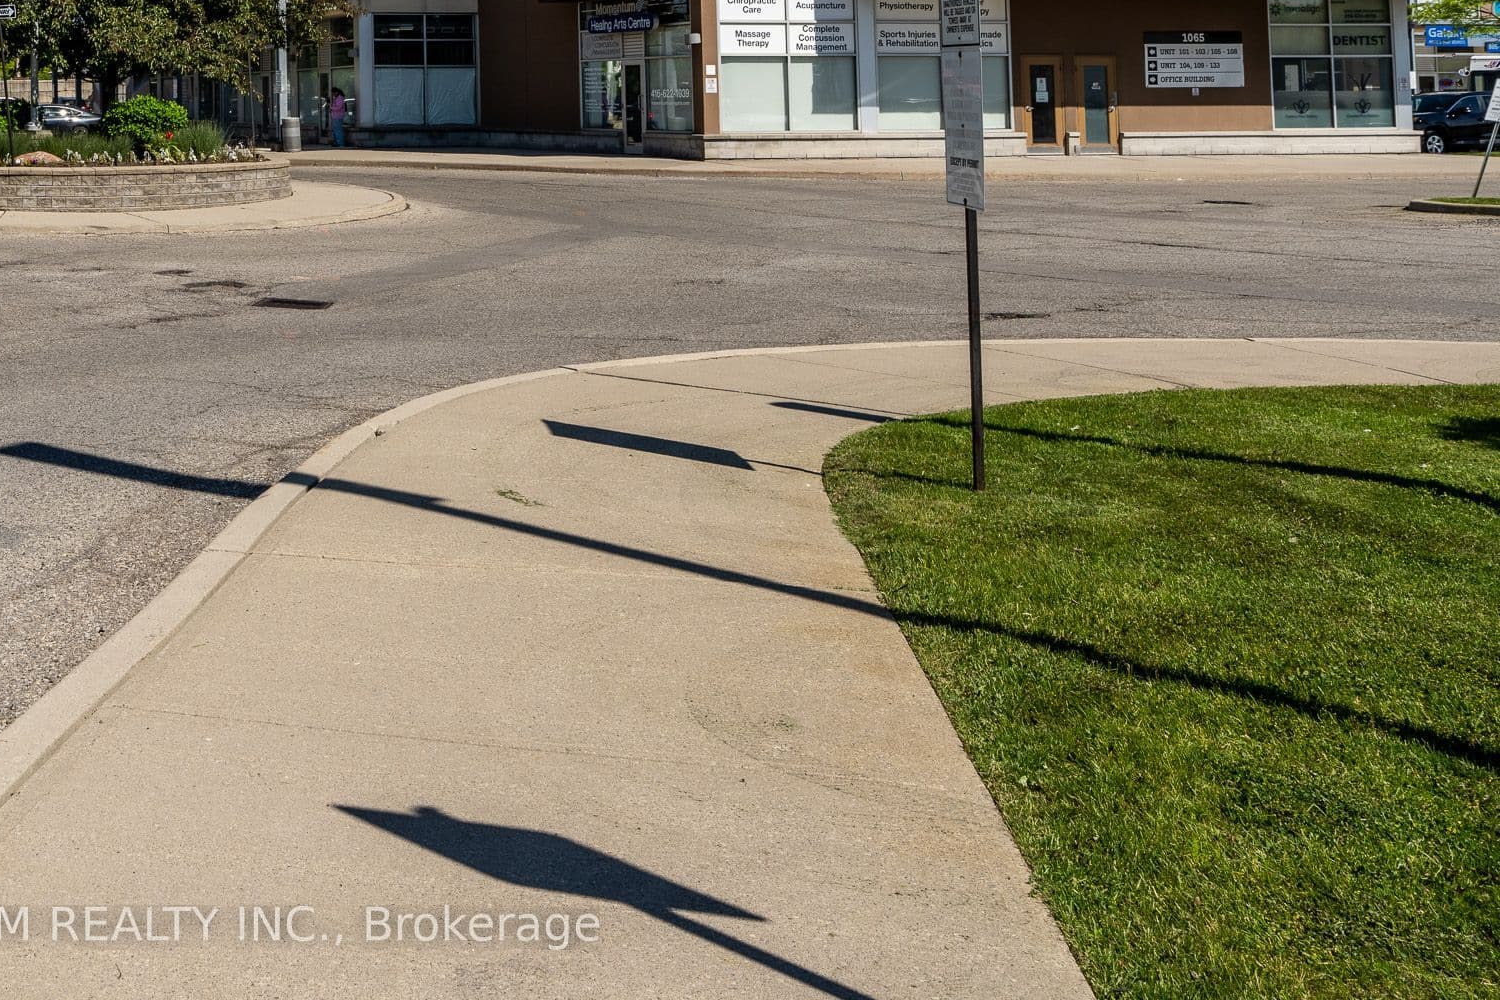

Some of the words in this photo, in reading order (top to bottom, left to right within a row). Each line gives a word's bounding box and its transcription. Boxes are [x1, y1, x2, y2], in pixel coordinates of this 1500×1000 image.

[596, 1, 636, 15] Momentum
[796, 2, 846, 11] Acupuncture
[880, 2, 934, 12] Physiotherapy
[590, 20, 612, 33] Healing
[613, 19, 627, 30] Arts
[627, 17, 651, 29] Centre
[802, 25, 840, 34] Complete
[735, 30, 771, 40] Massage
[798, 34, 845, 42] Concussion
[880, 31, 906, 40] Sports
[908, 31, 936, 41] Injuries
[1181, 33, 1205, 42] 1065
[737, 40, 769, 49] Therapy
[886, 40, 939, 48] Rehabilitation
[1333, 35, 1386, 46] DENTIST
[796, 43, 847, 54] Management
